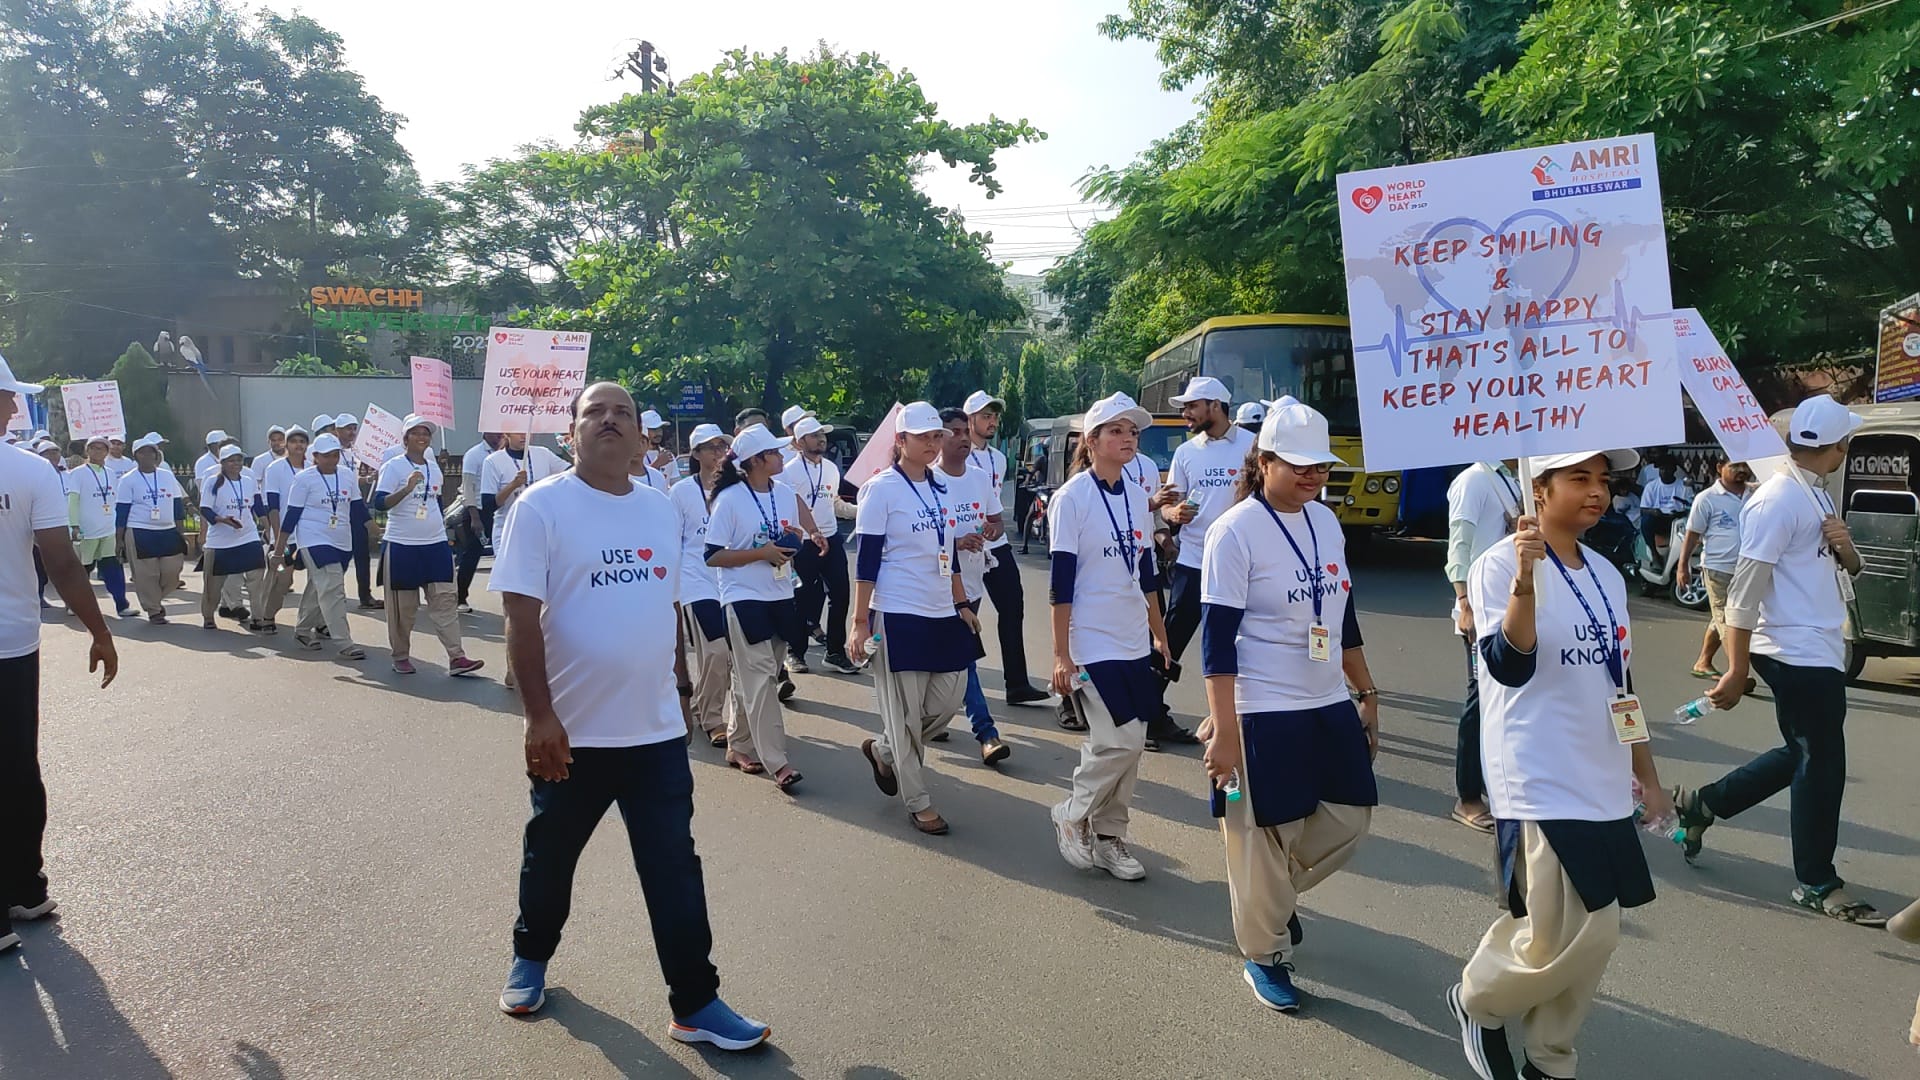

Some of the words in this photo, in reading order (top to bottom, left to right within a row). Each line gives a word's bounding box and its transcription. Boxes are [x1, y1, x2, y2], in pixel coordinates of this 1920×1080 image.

[1570, 144, 1640, 172] AMRI
[1572, 169, 1640, 183] HOSPITALS
[1387, 180, 1425, 191] WORLD
[1544, 181, 1629, 198] BHUBANESWAR
[1388, 190, 1422, 202] HEART
[1389, 202, 1409, 211] DAY
[1394, 239, 1467, 267] KEEP
[1480, 222, 1602, 258] SMILING
[1492, 268, 1511, 291] &
[311, 286, 422, 307] SWACHH
[1420, 305, 1491, 336] STAY
[1504, 294, 1598, 327] HAPPY
[452, 335, 489, 353] 202
[564, 335, 587, 343] AMRI
[1408, 340, 1508, 374] THAT'S
[1520, 334, 1579, 361] ALL
[1588, 329, 1626, 354] TO
[1693, 356, 1732, 372] BURN
[499, 368, 521, 379] USE
[523, 368, 550, 380] YOUR
[552, 370, 584, 381] HEART
[495, 386, 509, 396] TO
[512, 386, 562, 397] CONNECT
[563, 388, 583, 397] WIT
[1383, 382, 1455, 409] KEEP
[1467, 373, 1546, 403] YOUR
[1556, 360, 1653, 394] HEART
[500, 405, 544, 416] OTHER'S
[545, 406, 572, 416] HEAR
[1737, 395, 1758, 413] FO
[1453, 403, 1586, 440] HEALTHY
[1205, 469, 1225, 477] USE
[1199, 479, 1232, 487] KNOW
[917, 508, 939, 519] USE
[954, 503, 971, 513] USE
[957, 512, 977, 523] NOW
[602, 549, 635, 565] USE
[591, 567, 648, 588] KNOW
[1574, 624, 1609, 642] USE
[1561, 647, 1605, 666] KNO
